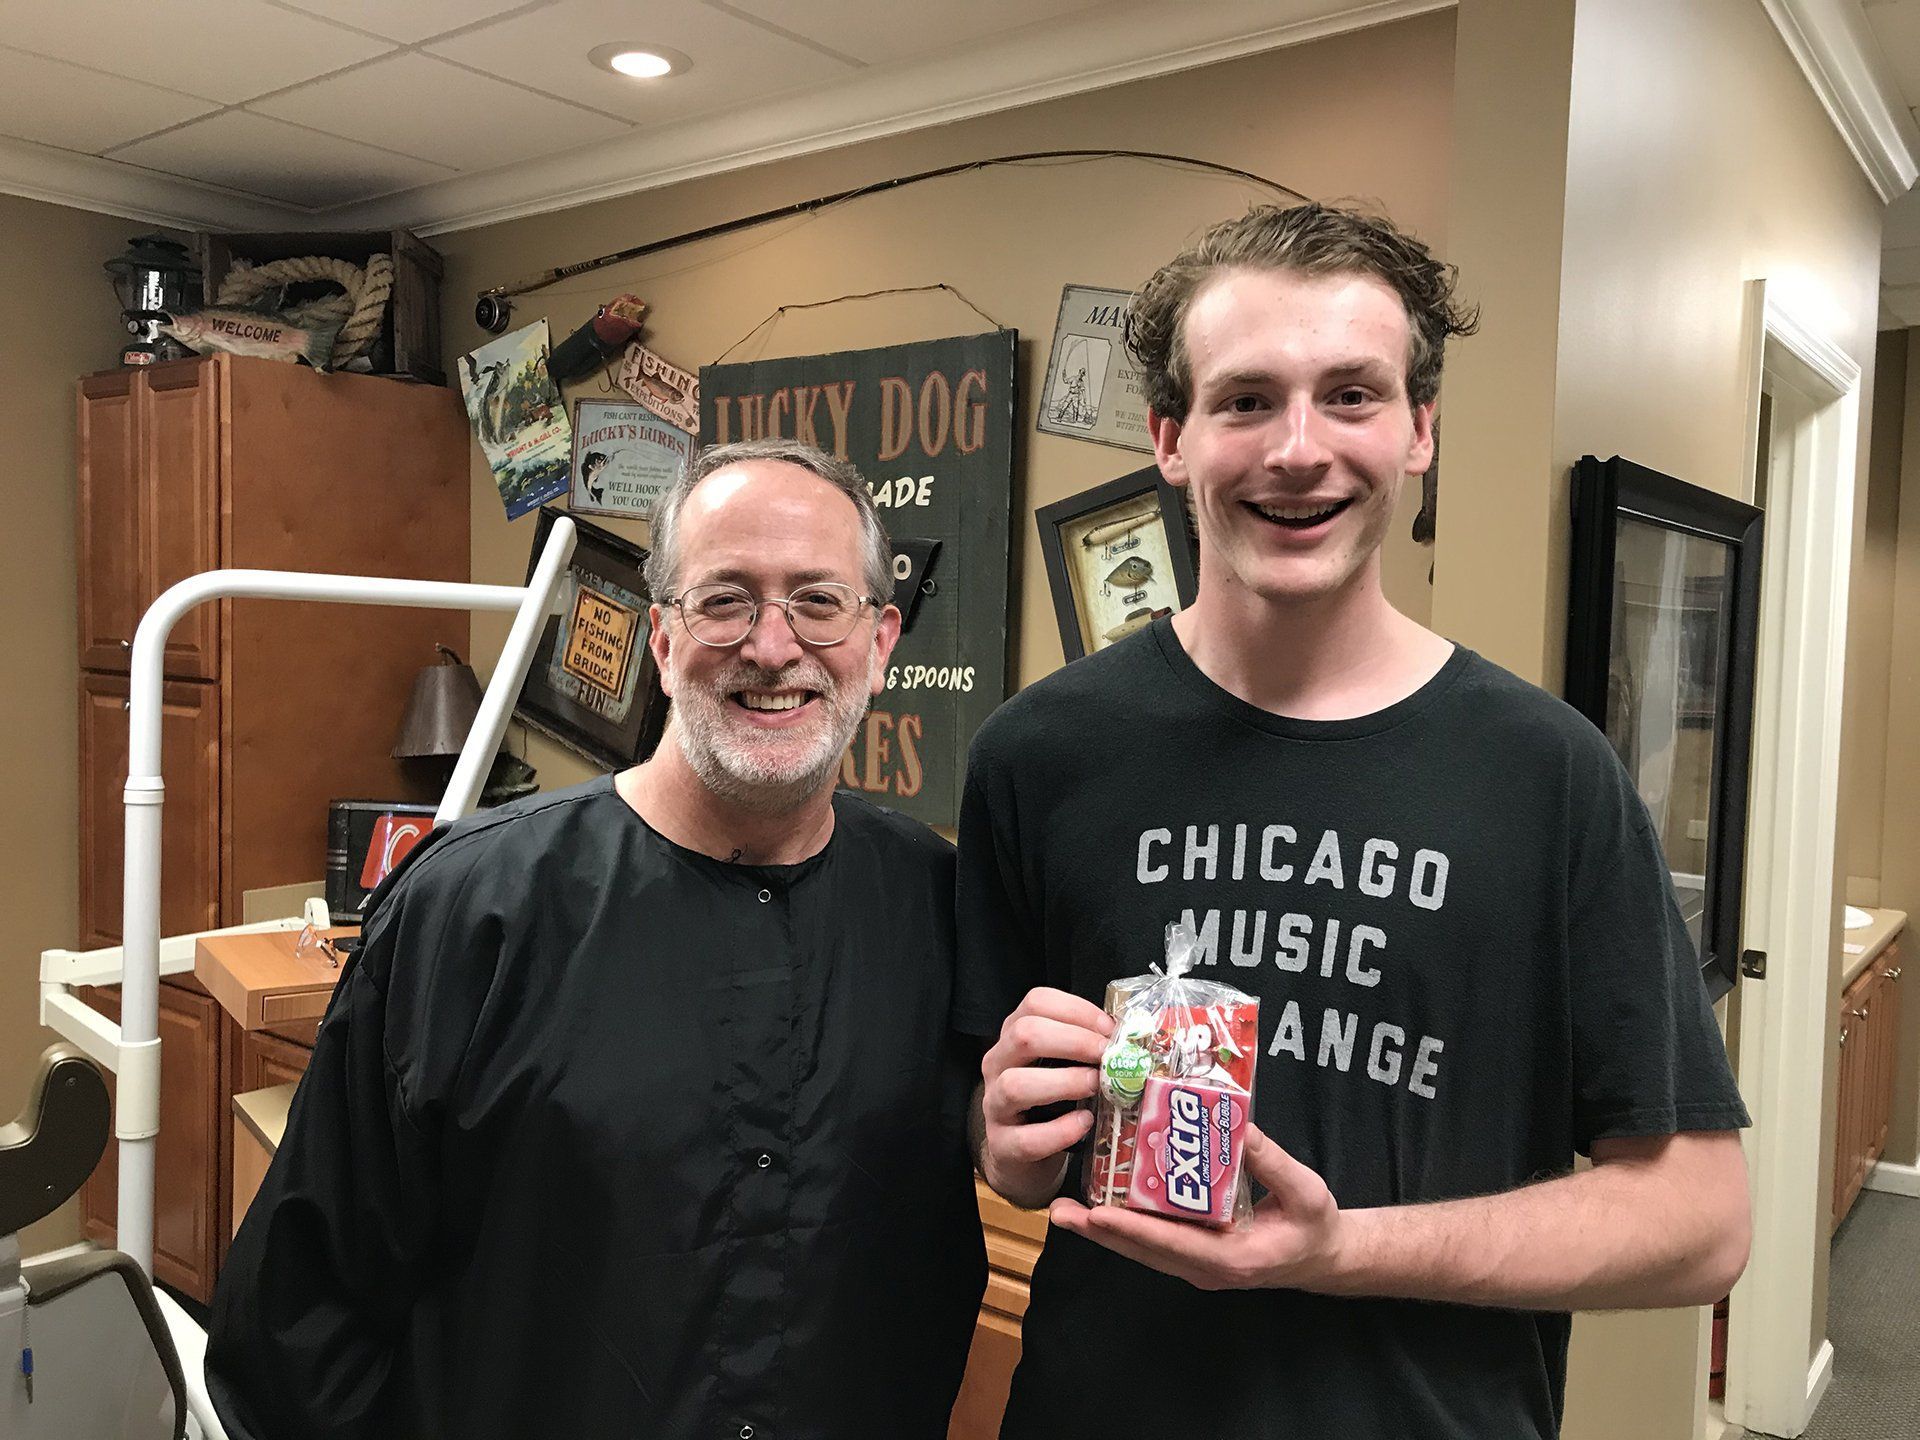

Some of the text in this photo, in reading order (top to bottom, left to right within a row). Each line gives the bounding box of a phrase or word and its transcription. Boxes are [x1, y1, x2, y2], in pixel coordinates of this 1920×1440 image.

[211, 318, 282, 343] WELCOME
[603, 411, 618, 420] FISH
[629, 383, 683, 423] EXPEDITIONS
[714, 369, 988, 463] LUCKY DOG
[581, 424, 685, 456] LUCKY'S LURES
[608, 481, 634, 493] WE'LL
[635, 484, 661, 496] HOOK
[611, 495, 630, 506] YOU
[866, 475, 935, 509] ADE
[593, 606, 612, 625] NO
[577, 617, 624, 650] FISHING
[581, 637, 613, 664] FROM
[573, 652, 615, 685] BRIDGE
[886, 665, 975, 692] & SPOONS
[577, 681, 608, 712] FUN
[1136, 823, 1450, 911] CHICAGO
[1180, 908, 1388, 988] MUSIC
[1267, 1000, 1445, 1099] ANGE
[1115, 1070, 1134, 1078] SOUR
[1219, 1093, 1231, 1128] BUBBLE
[1166, 1087, 1210, 1212] Extra
[1201, 1107, 1211, 1183] LONG LASTING FLAVOR
[1219, 1129, 1231, 1165] CLASSIC
